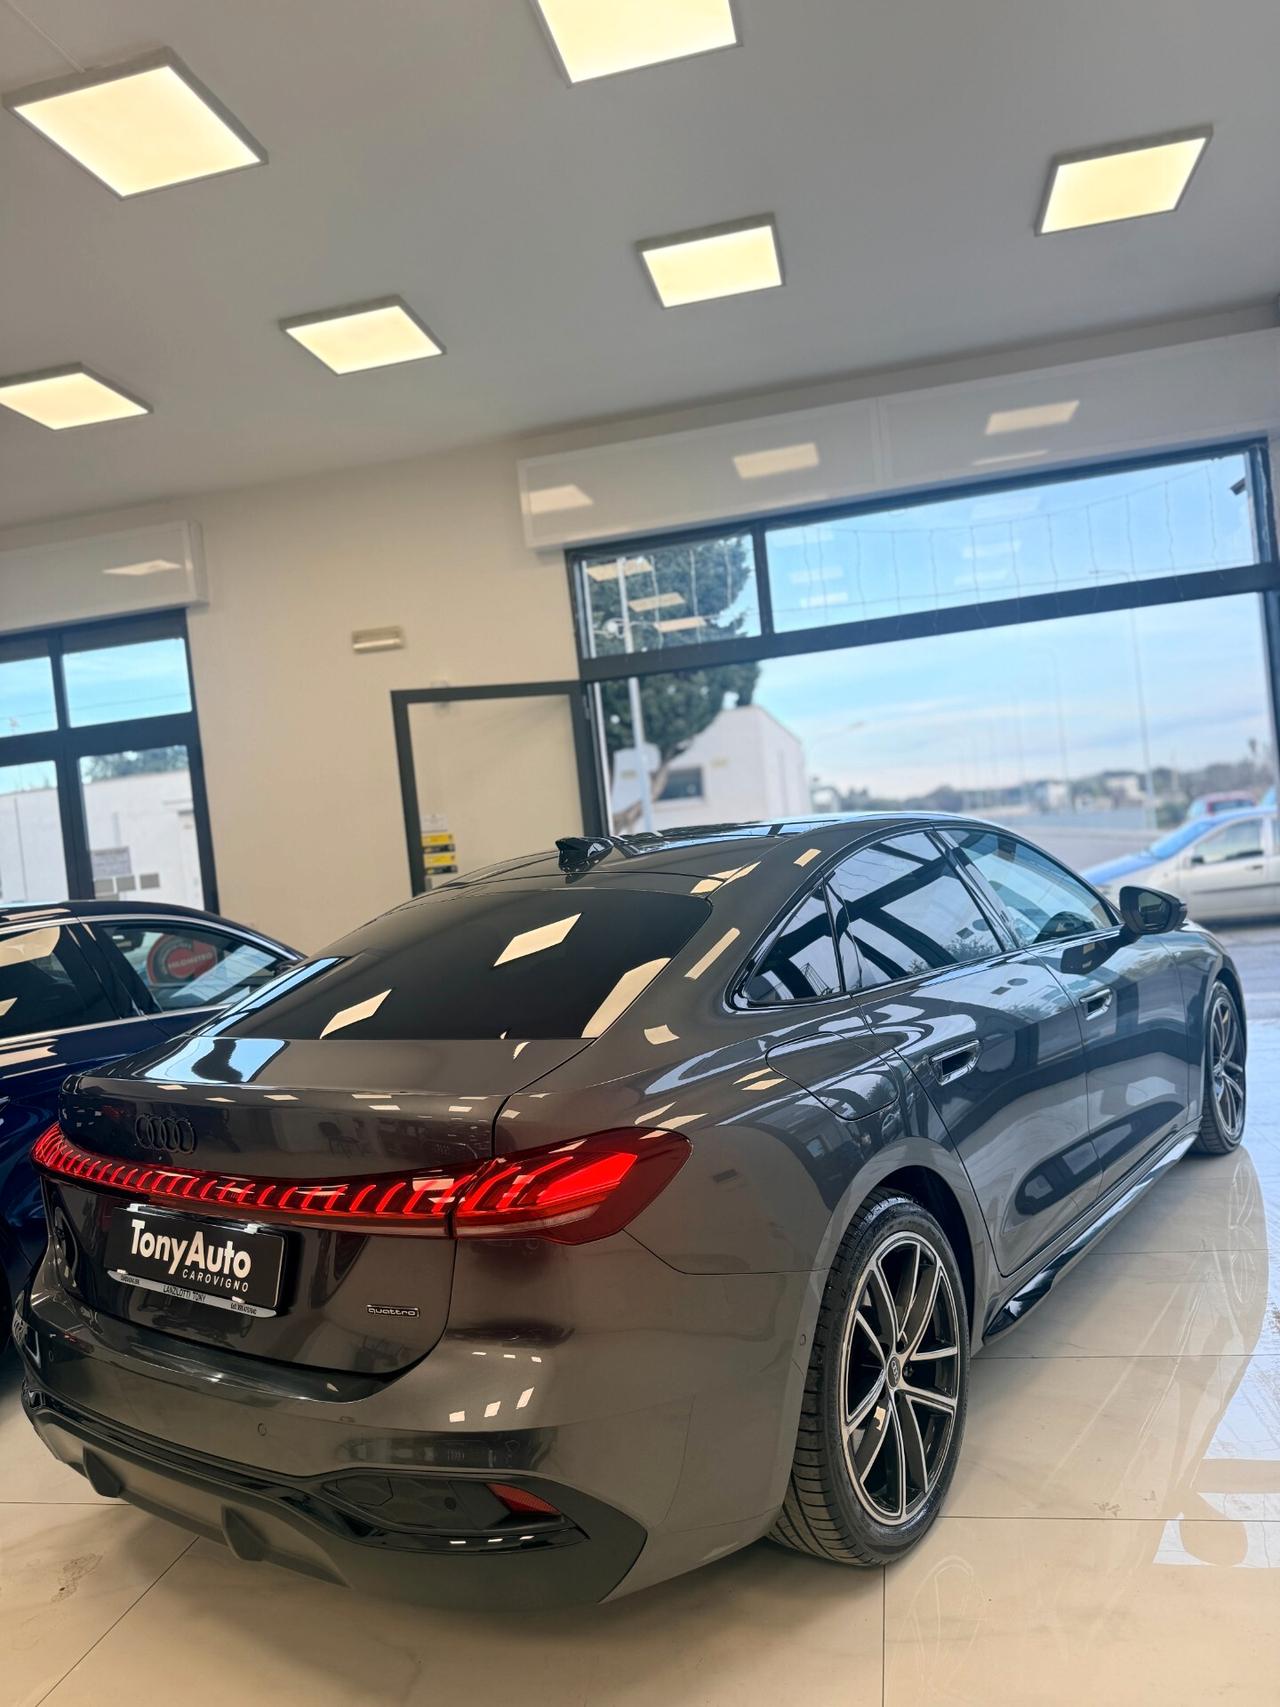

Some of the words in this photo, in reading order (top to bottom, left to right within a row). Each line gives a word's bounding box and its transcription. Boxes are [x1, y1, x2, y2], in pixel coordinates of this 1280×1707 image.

[131, 1218, 251, 1279] TonyAuto
[182, 1268, 249, 1293] CAROVIGNO
[368, 1307, 416, 1316] quattro
